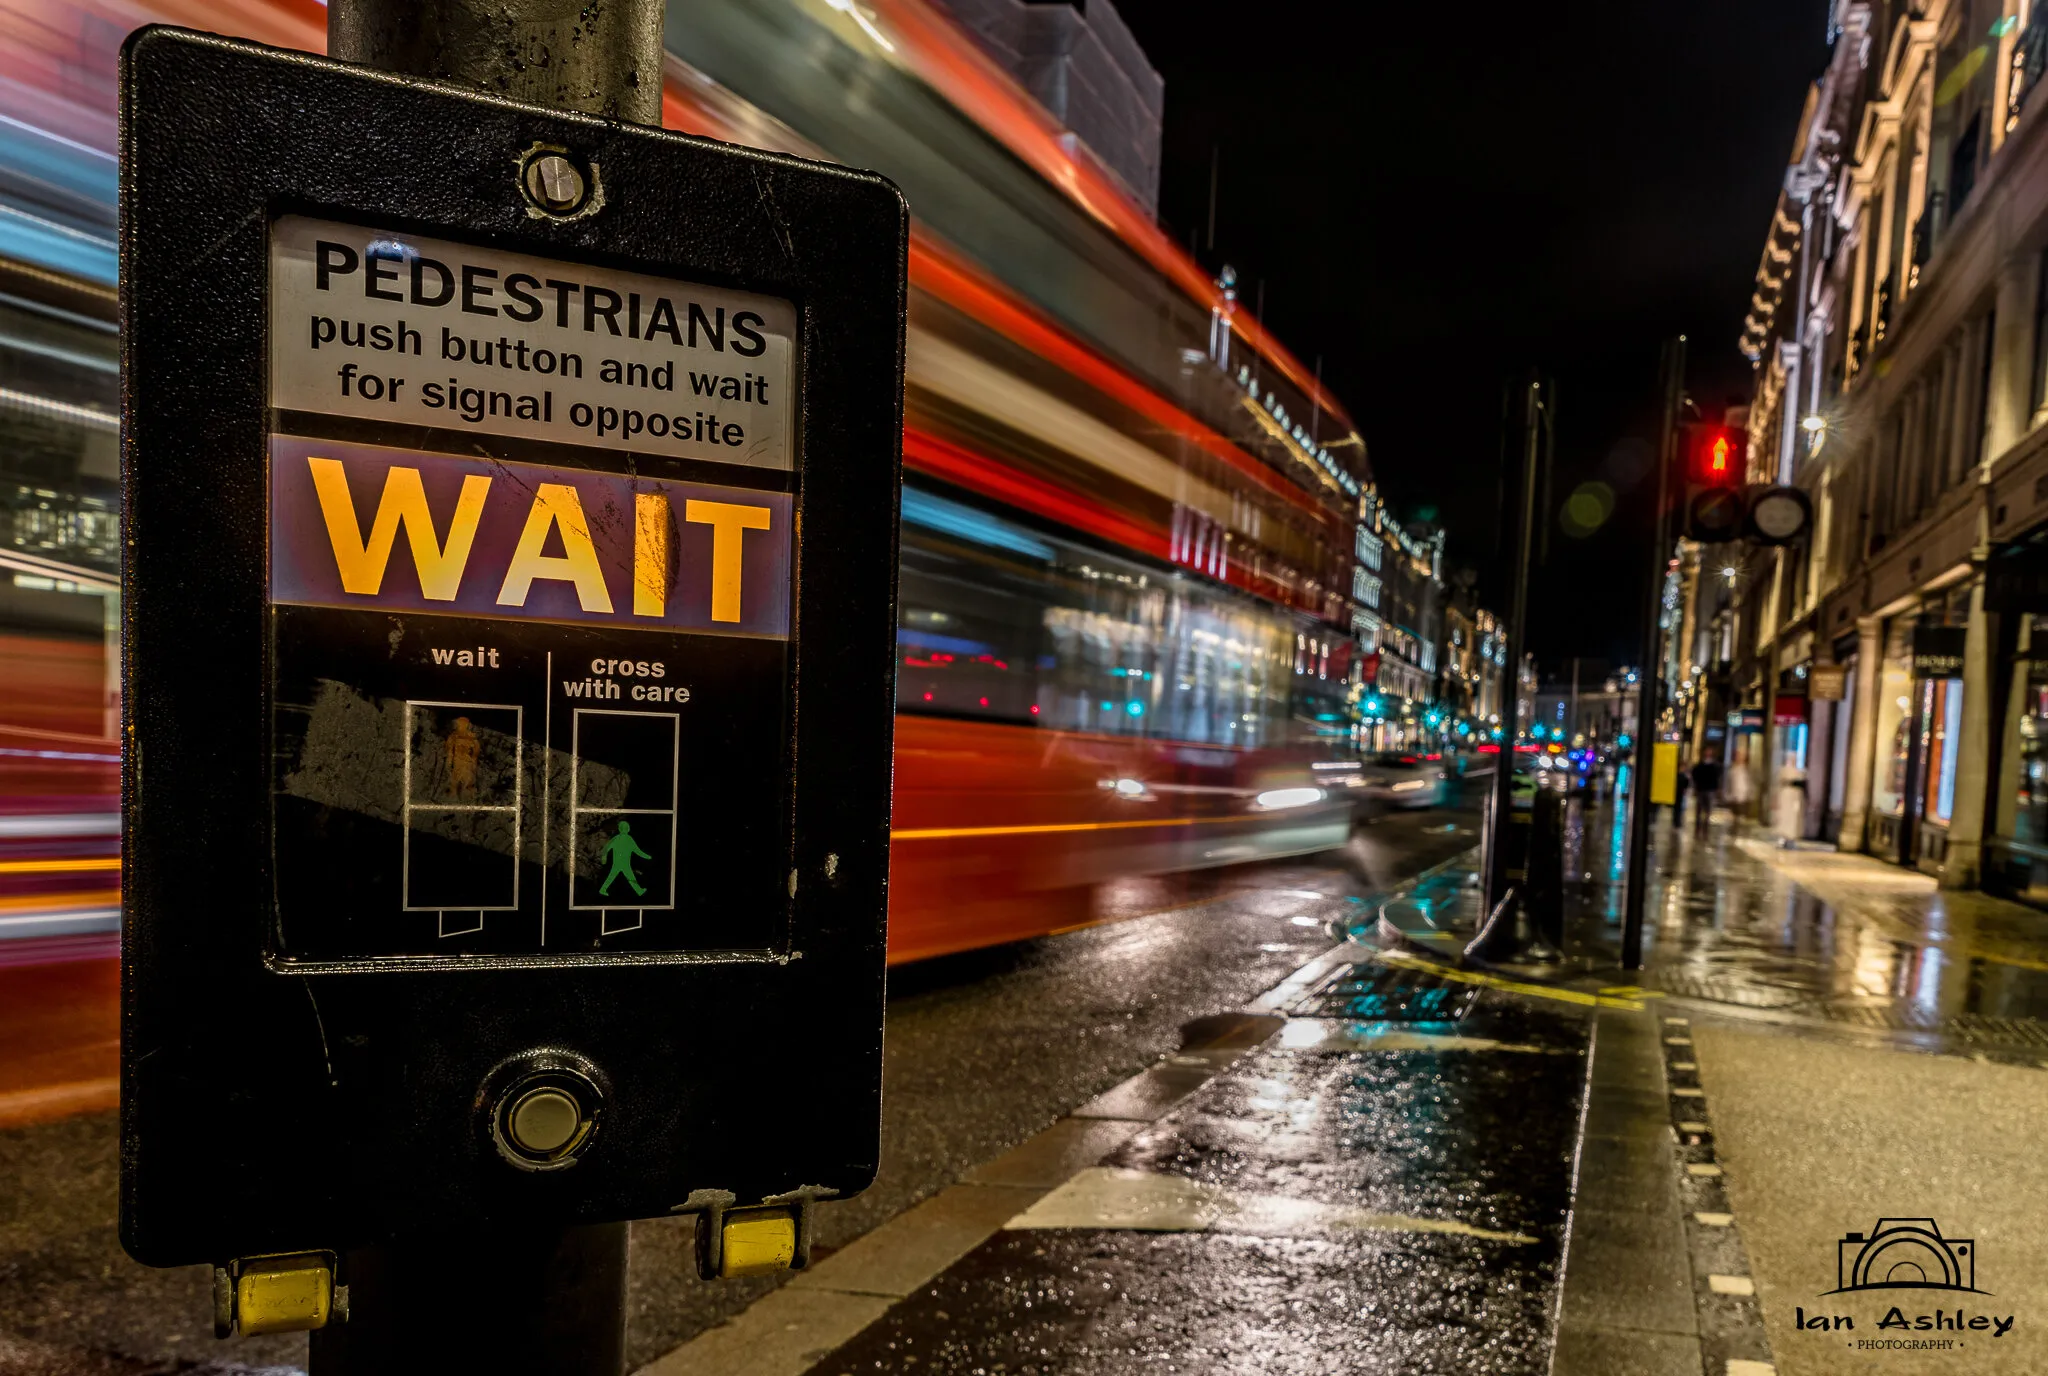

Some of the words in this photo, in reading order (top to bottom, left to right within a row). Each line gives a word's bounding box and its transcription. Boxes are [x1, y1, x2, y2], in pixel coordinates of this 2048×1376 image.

[315, 239, 767, 358] PEDESTRIANS
[310, 314, 423, 356] push
[441, 327, 583, 379] button
[600, 359, 675, 392] and
[688, 371, 769, 406] wait
[338, 364, 405, 402] for
[421, 377, 552, 423] signal
[569, 401, 745, 448] opposite
[307, 456, 771, 624] WAIT
[431, 646, 500, 669] wait
[563, 678, 621, 700] with
[631, 682, 691, 703] care
[591, 657, 666, 678] cross
